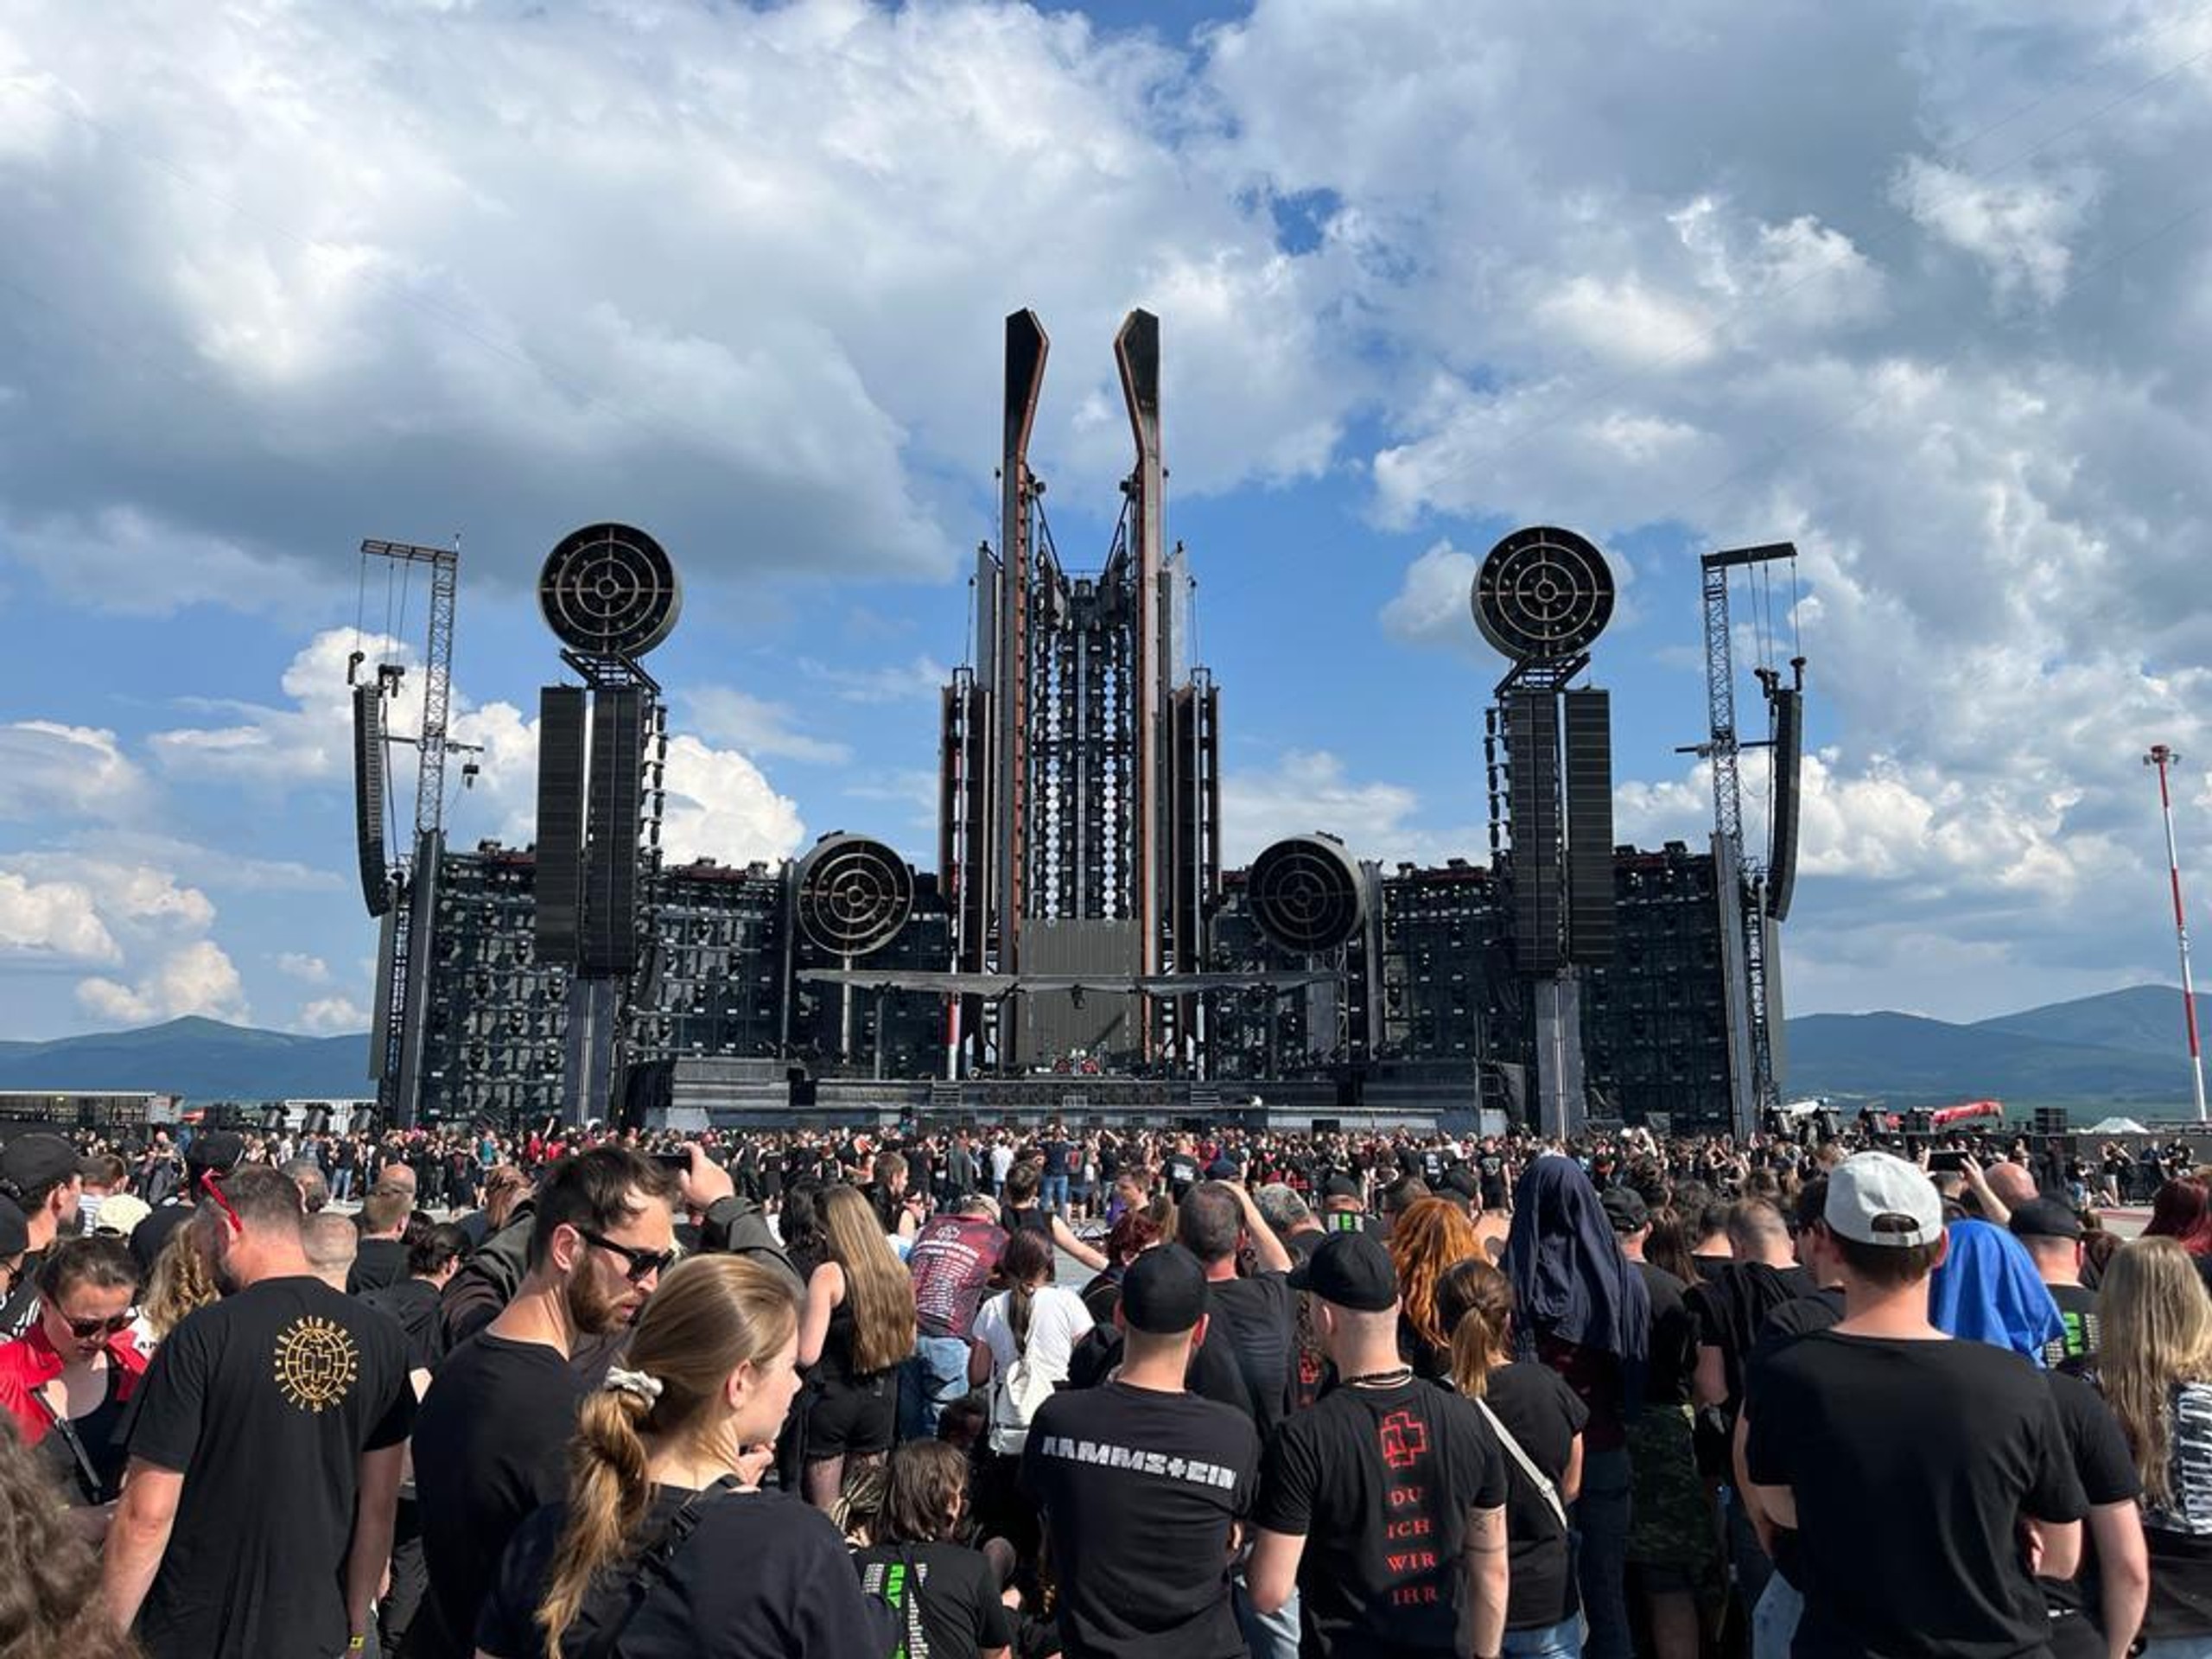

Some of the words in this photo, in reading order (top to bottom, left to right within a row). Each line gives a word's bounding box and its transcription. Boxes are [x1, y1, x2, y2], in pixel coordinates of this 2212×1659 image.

[1390, 1487, 1422, 1507] DU
[1387, 1519, 1431, 1540] ICH
[1386, 1553, 1437, 1573] WIR
[1392, 1586, 1438, 1606] IHR
